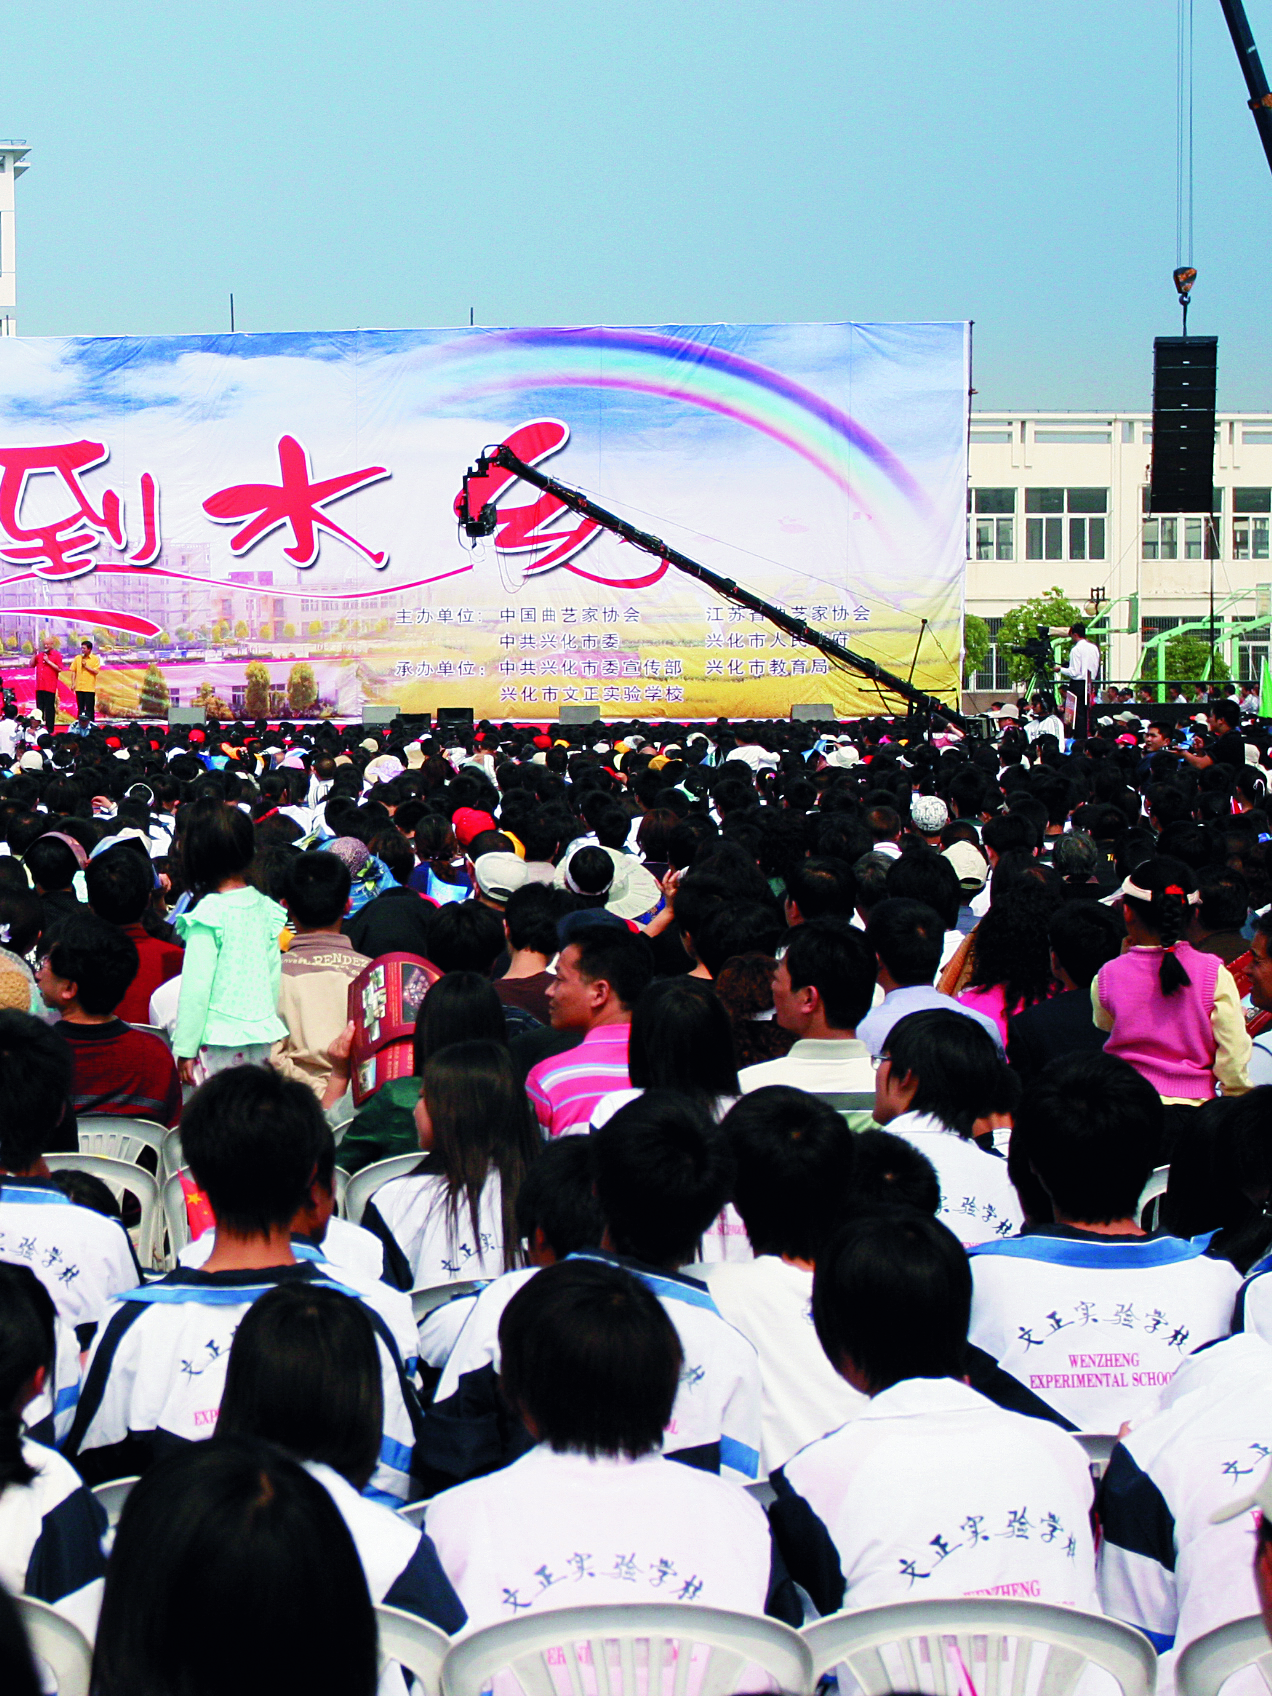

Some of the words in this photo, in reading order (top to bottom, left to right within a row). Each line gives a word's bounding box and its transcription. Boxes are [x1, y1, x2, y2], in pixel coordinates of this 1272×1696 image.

[499, 607, 640, 623] 中国曲艺家协会
[705, 605, 871, 622] 江苏省艺家协会
[499, 633, 620, 650] 中共兴化市委
[705, 632, 849, 649] 兴化市人民府
[499, 659, 683, 677] 中共兴化市委宣传部
[705, 658, 828, 676] 兴化市教育局
[500, 685, 685, 703] 兴化市文正实验学校
[1069, 1352, 1140, 1369] WENZHENG
[1029, 1373, 1128, 1390] EXPERIMENTAL
[1132, 1371, 1177, 1387] SCHOO
